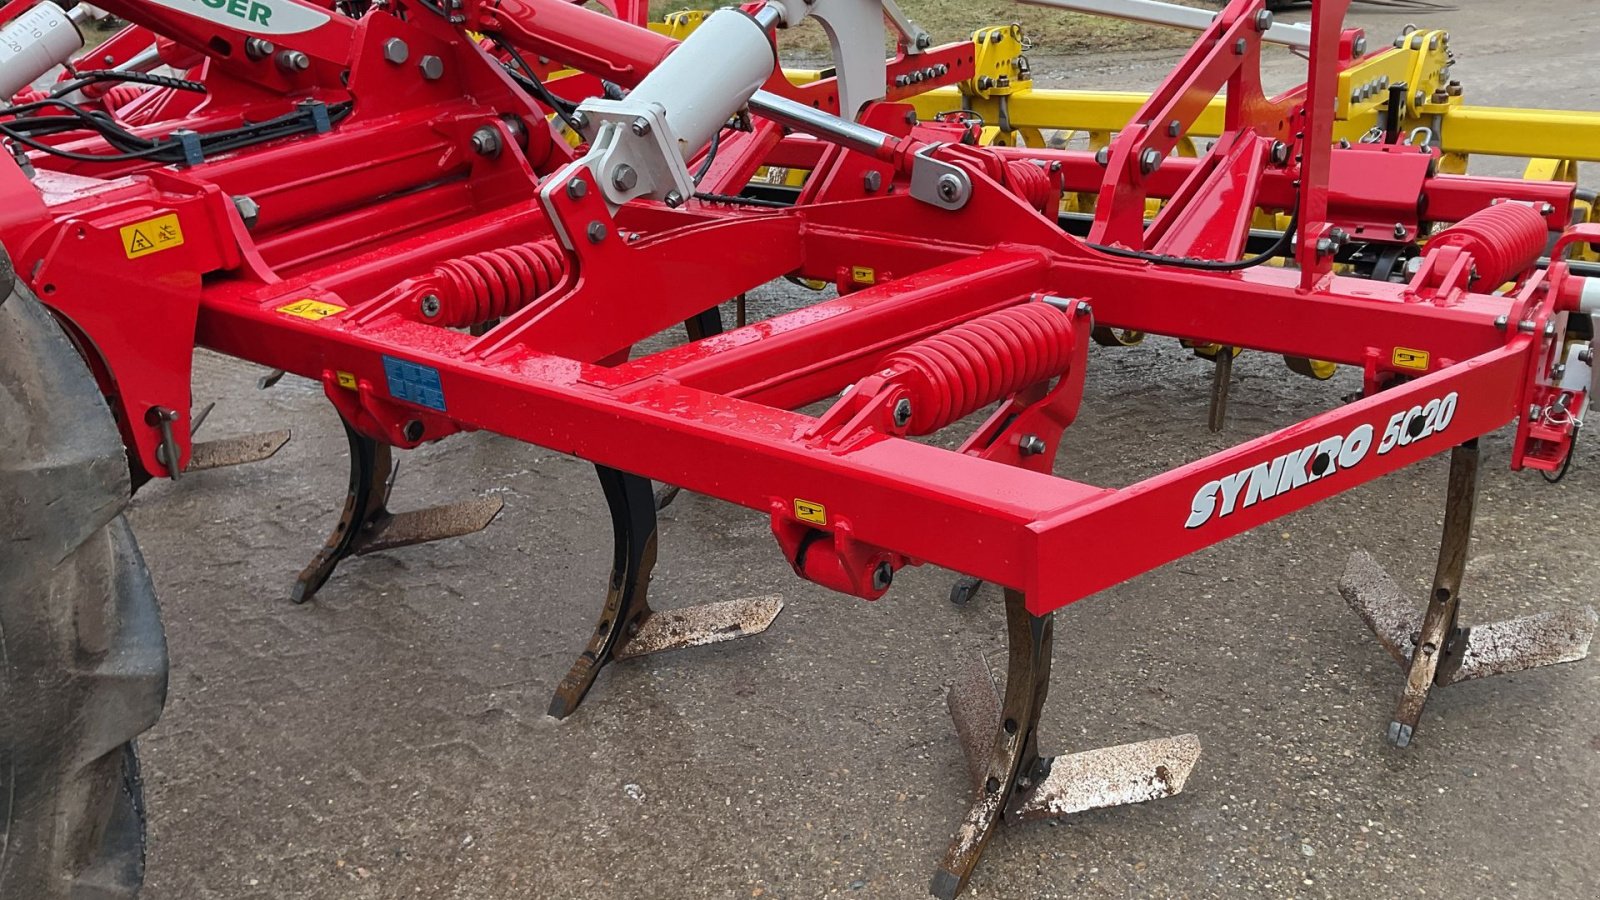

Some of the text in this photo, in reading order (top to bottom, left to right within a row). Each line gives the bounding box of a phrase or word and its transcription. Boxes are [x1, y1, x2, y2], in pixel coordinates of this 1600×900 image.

[49, 20, 58, 28] 0
[31, 28, 43, 39] 10
[8, 41, 22, 52] 20
[1184, 392, 1459, 529] SYNKRO 5020
